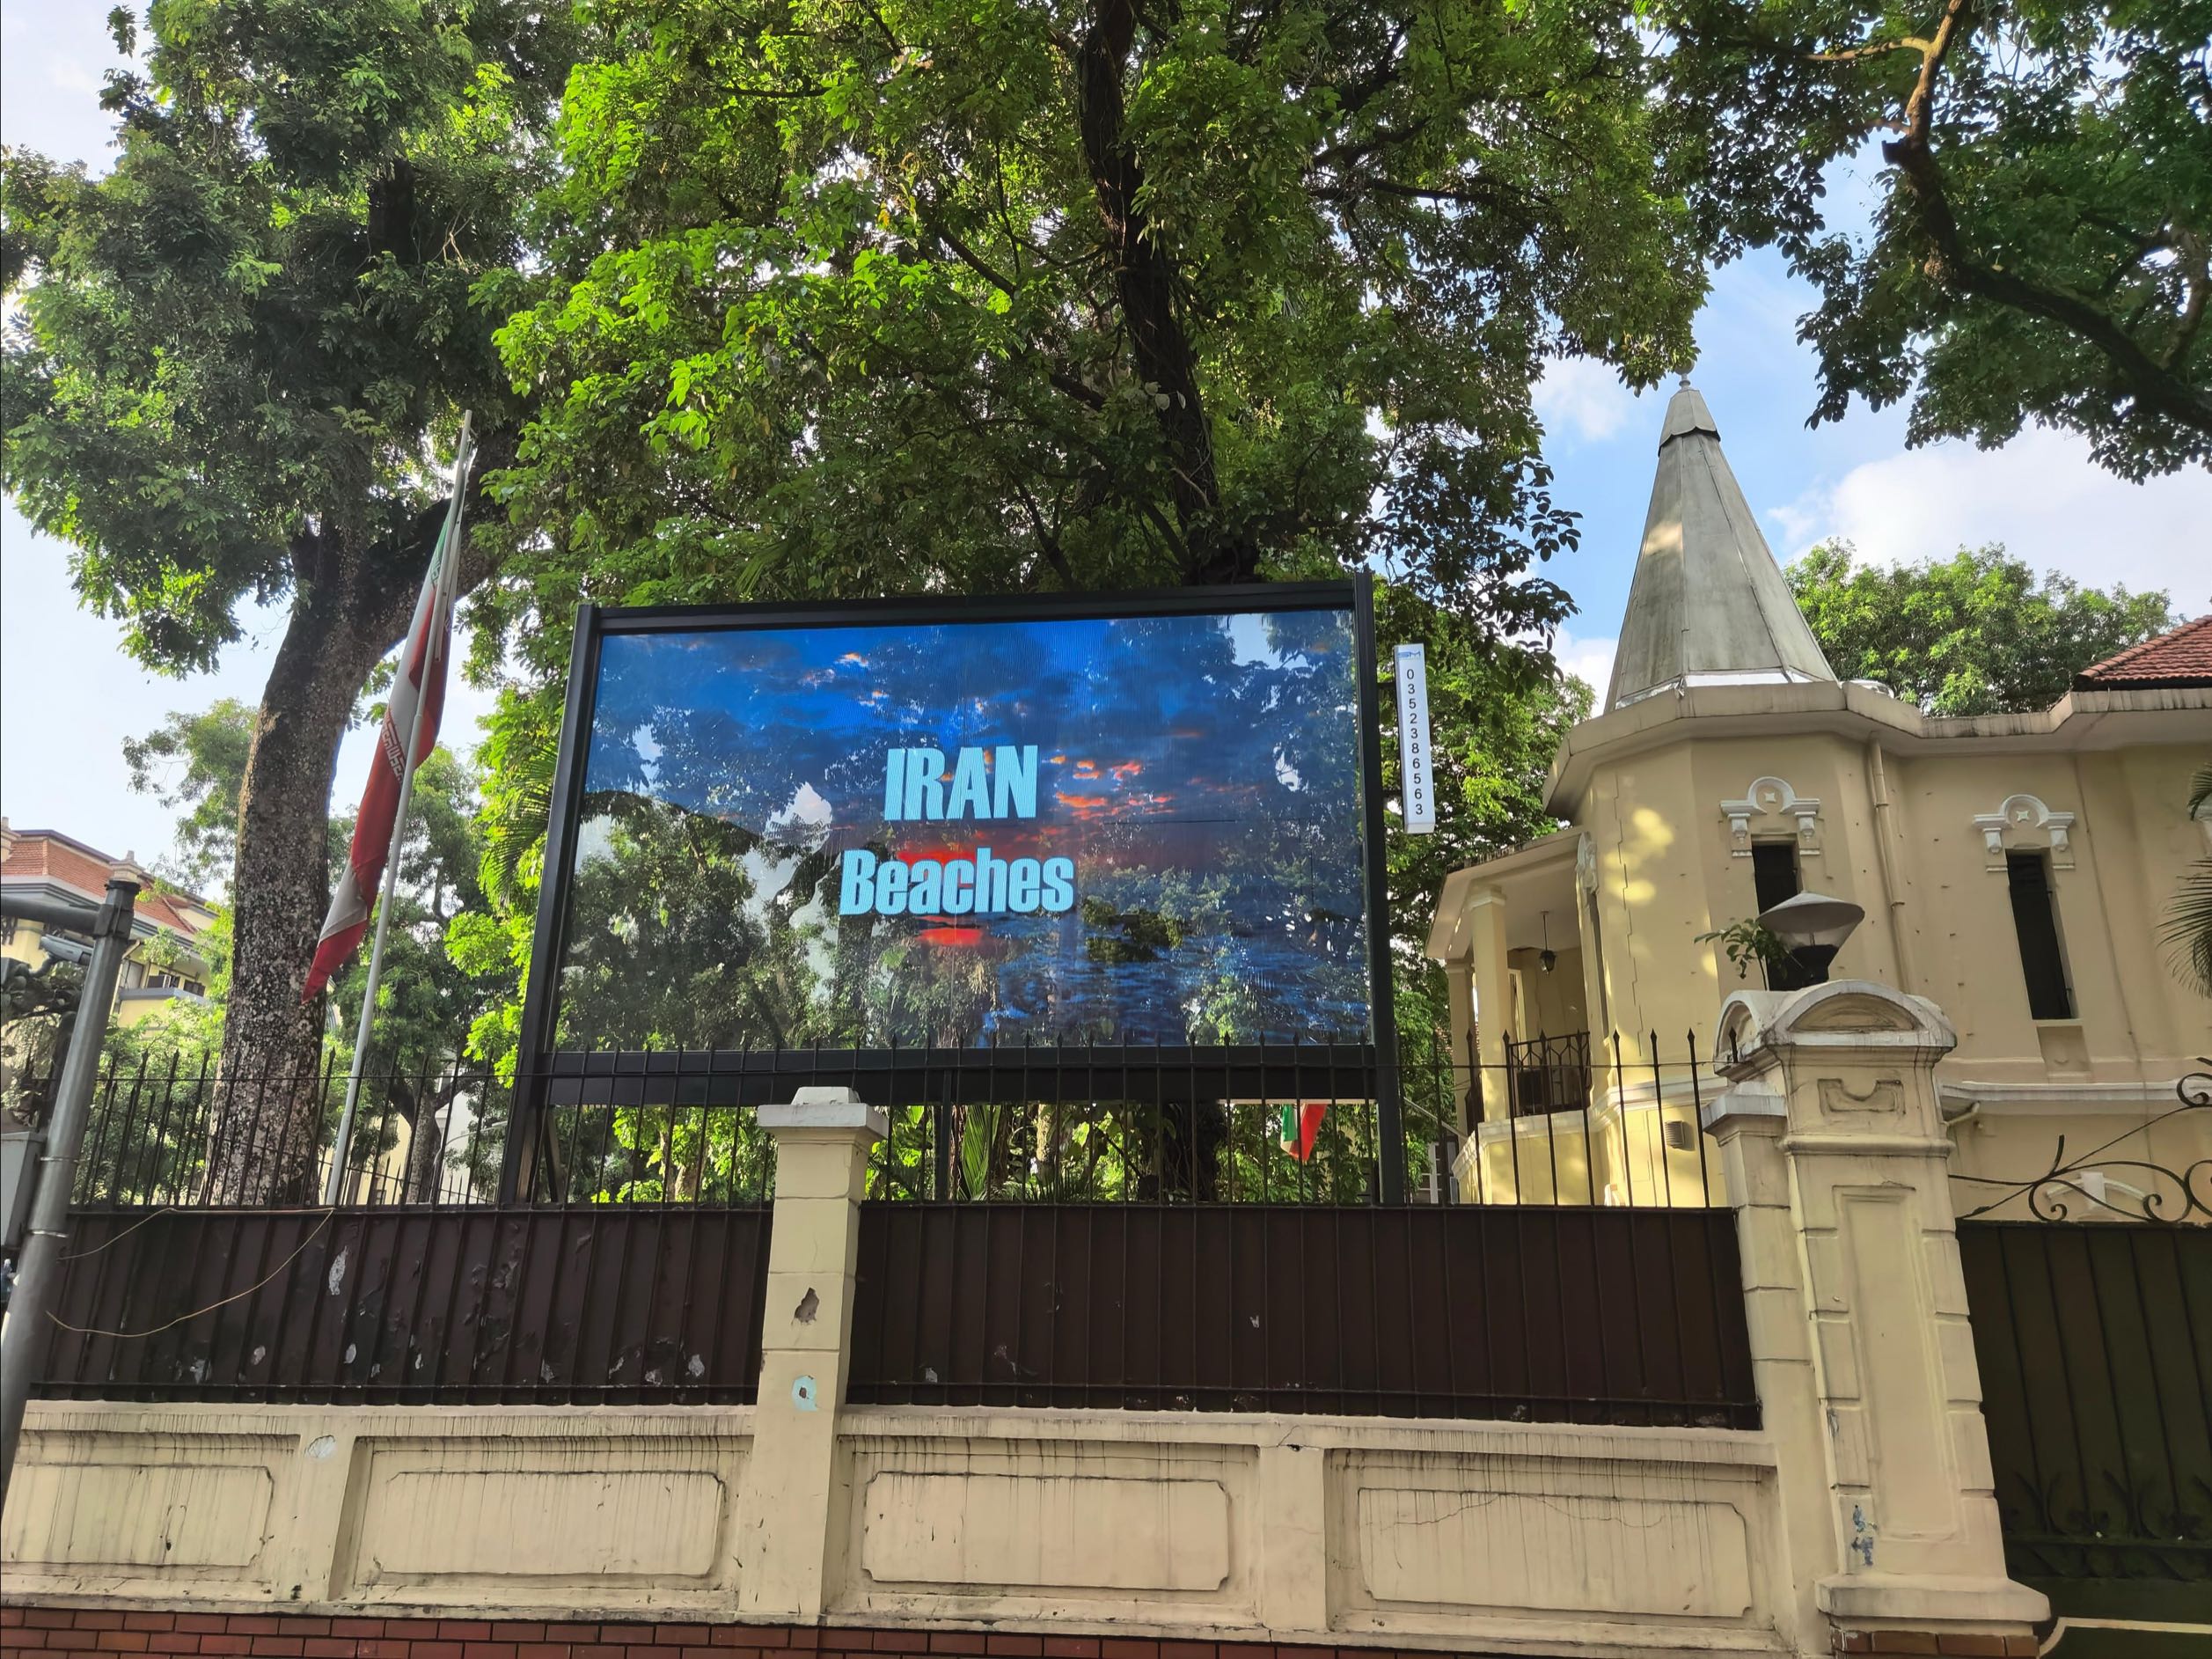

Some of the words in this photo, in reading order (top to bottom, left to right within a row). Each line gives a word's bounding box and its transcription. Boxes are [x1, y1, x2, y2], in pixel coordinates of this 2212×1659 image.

[1406, 668, 1424, 815] 0352386563
[884, 745, 1038, 821] IRAN
[839, 848, 1074, 915] Beaches
